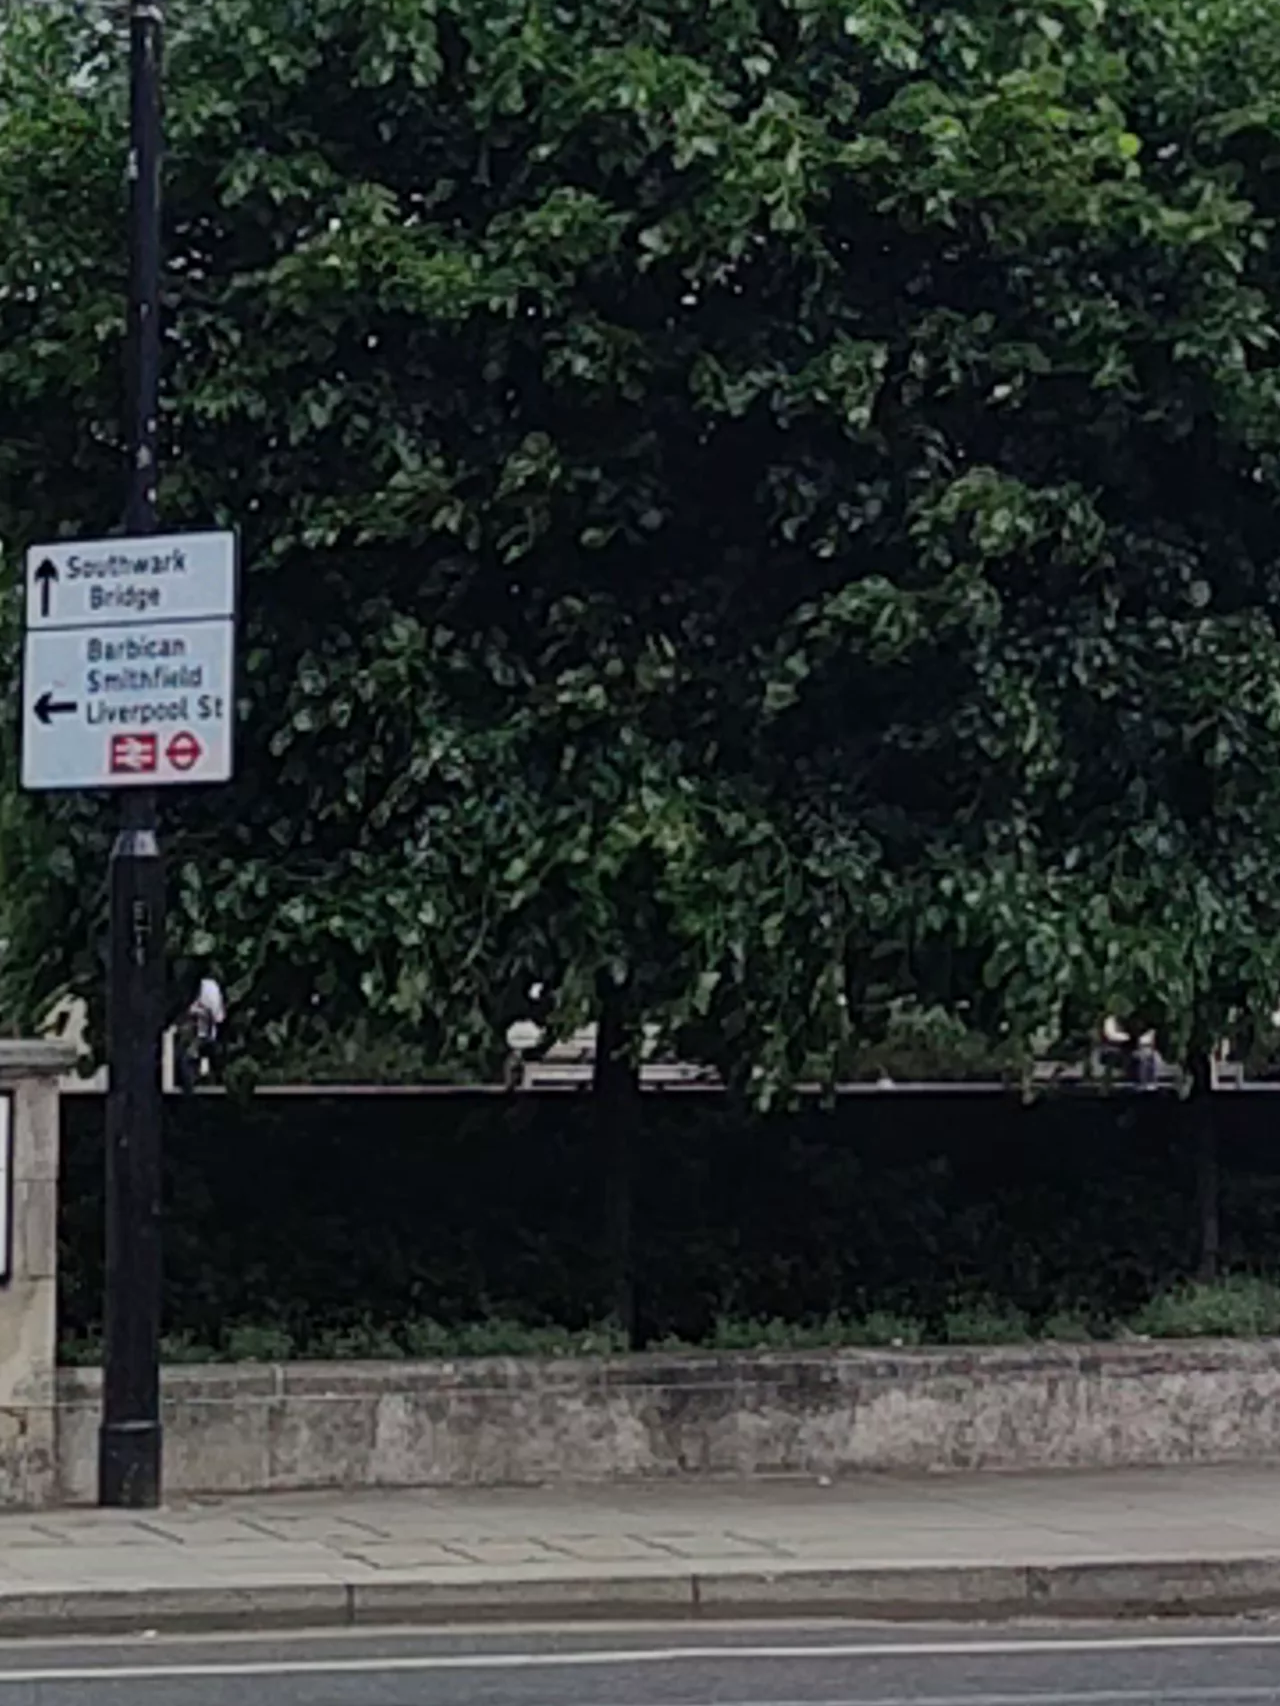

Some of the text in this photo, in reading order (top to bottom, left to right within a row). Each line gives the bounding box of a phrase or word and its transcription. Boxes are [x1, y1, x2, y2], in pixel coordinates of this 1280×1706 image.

[66, 549, 186, 579] Southwark
[89, 585, 160, 611] Bridge
[87, 636, 185, 661] Barbican
[86, 666, 203, 693] Smithfield
[86, 695, 223, 726] Liverpool St
